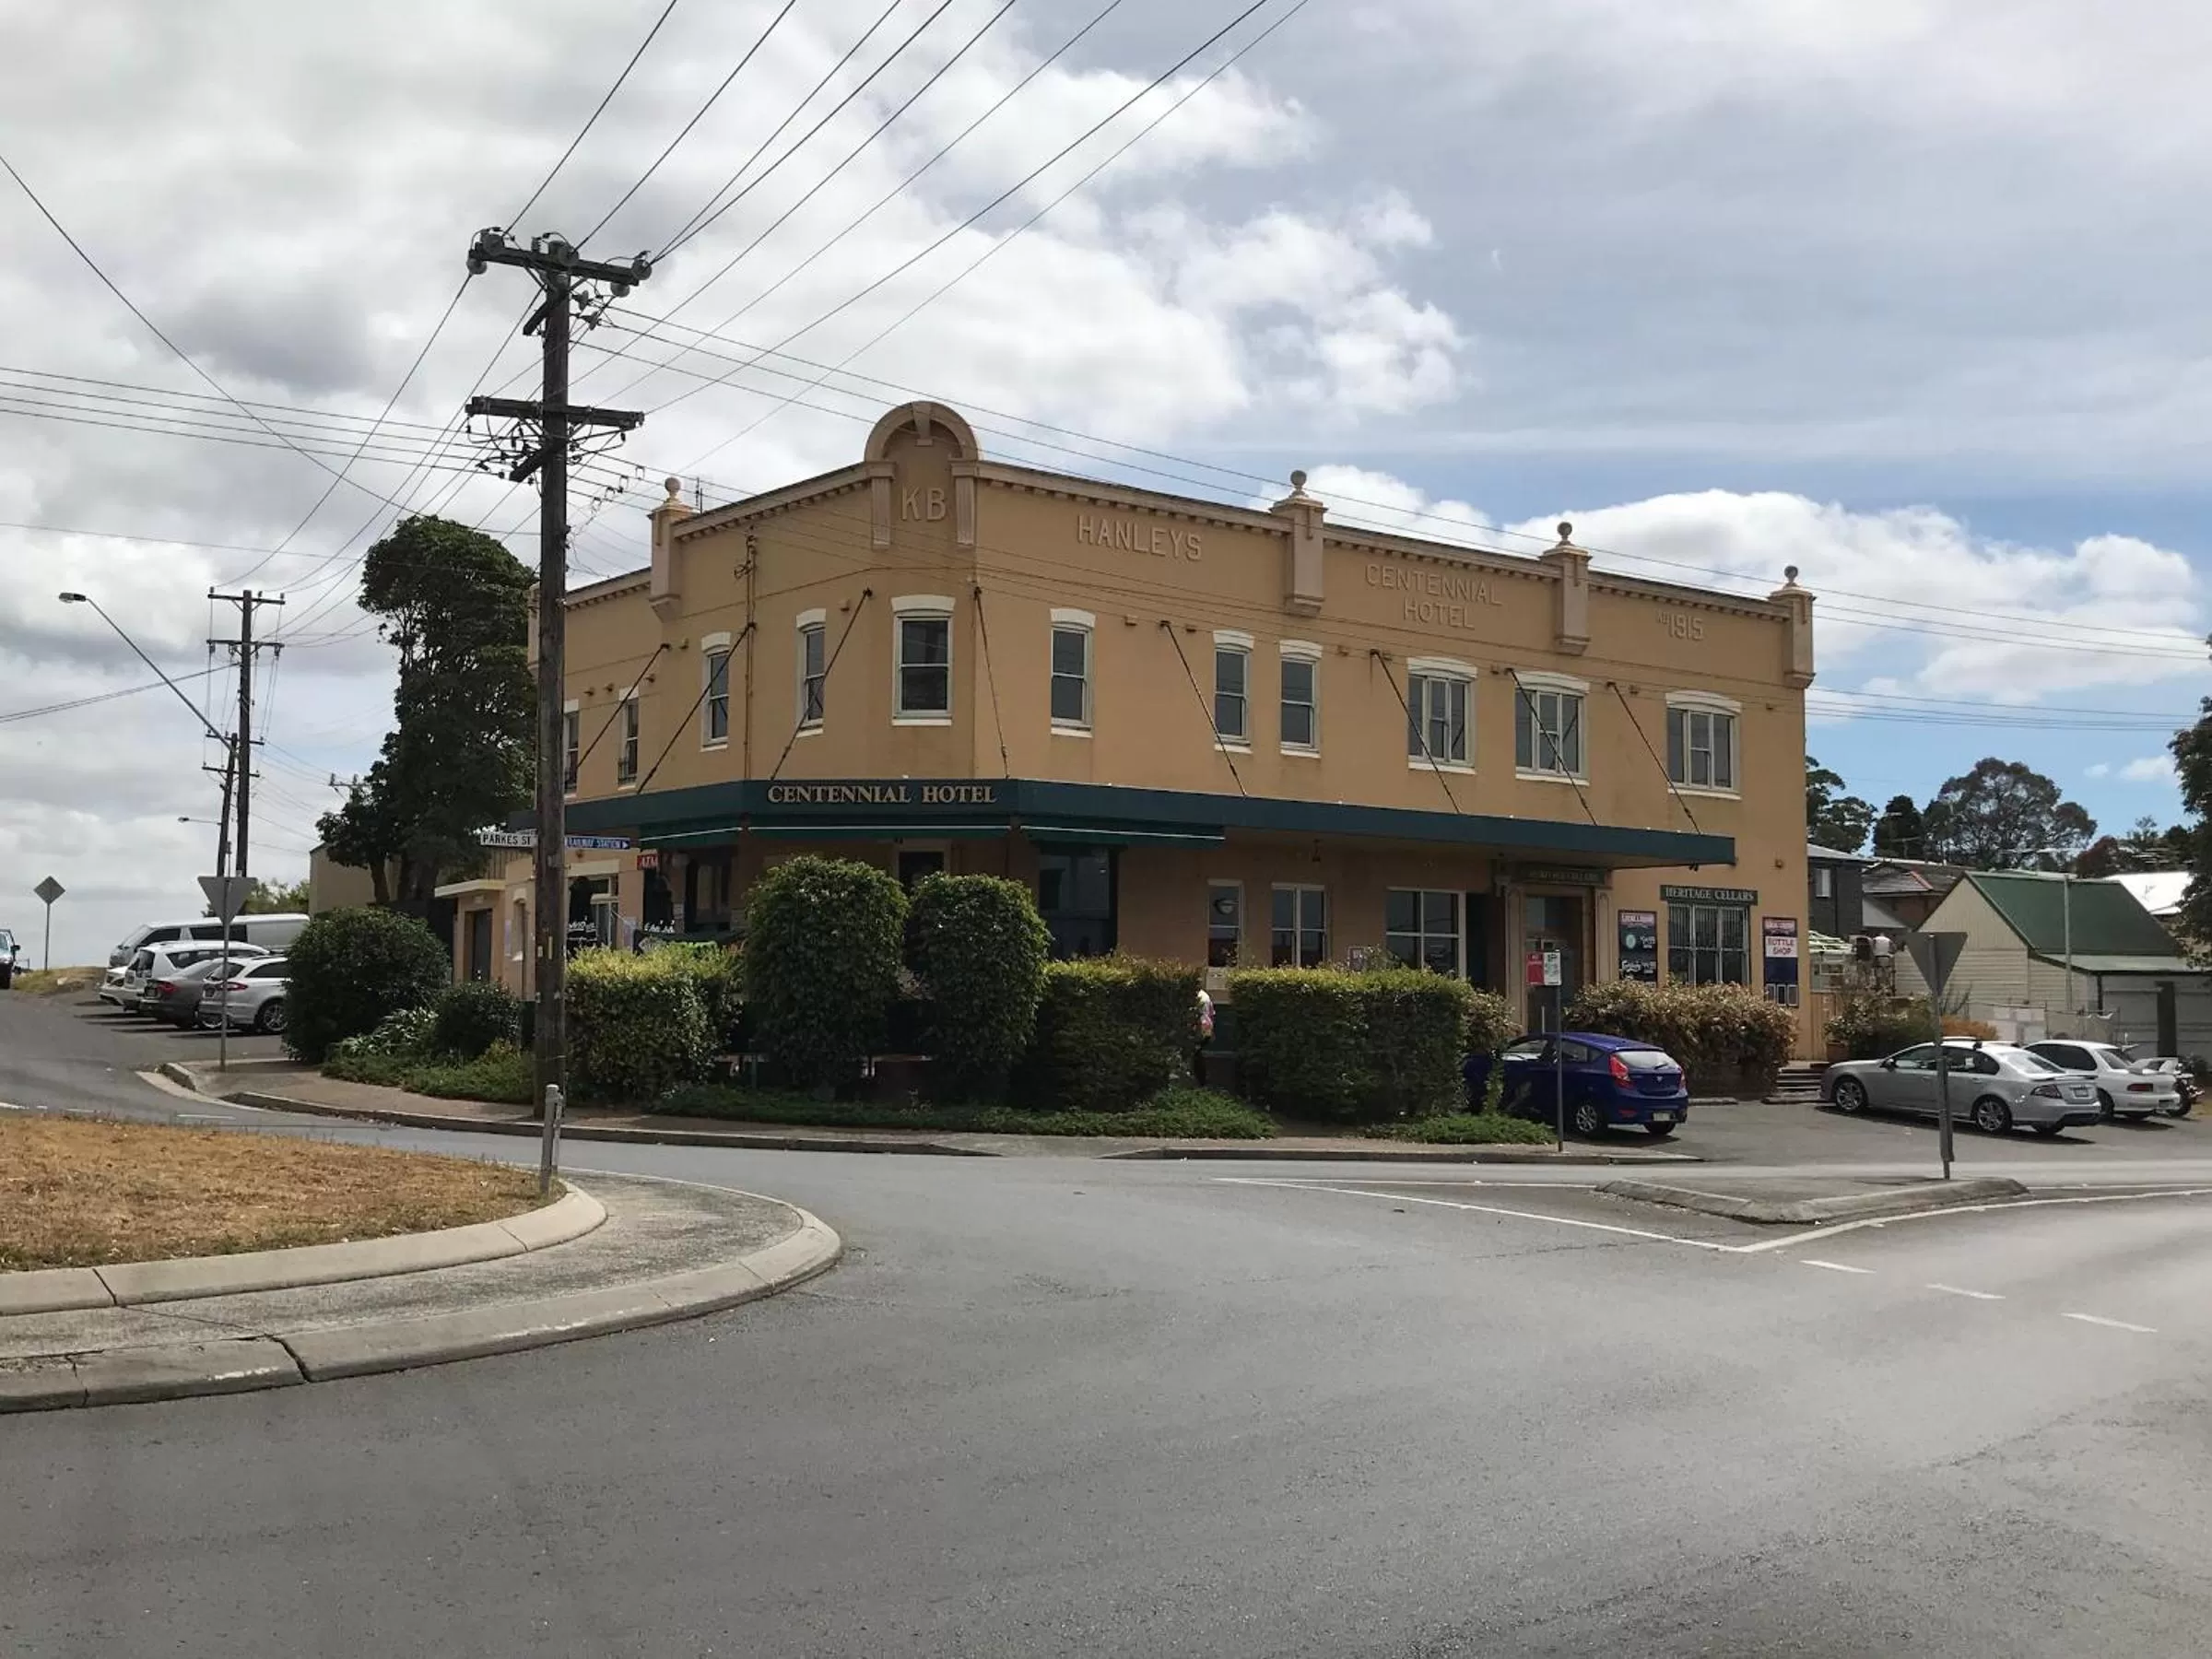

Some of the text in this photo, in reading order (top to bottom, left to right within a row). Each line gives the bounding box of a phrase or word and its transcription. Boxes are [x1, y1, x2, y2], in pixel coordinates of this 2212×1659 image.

[900, 488, 947, 522] KB
[1077, 514, 1203, 560] HANLEYS
[1365, 563, 1503, 606] CENTENNIAL
[1404, 597, 1475, 629] HOTEL
[1668, 614, 1704, 641] 1915
[767, 785, 998, 804] CENTENNIAL HOTEL
[483, 833, 532, 845] PARKES ST
[1665, 887, 1755, 901] HERITAGE CELLARS
[1767, 937, 1794, 947] BOTTLE
[1772, 947, 1792, 955] SHOP
